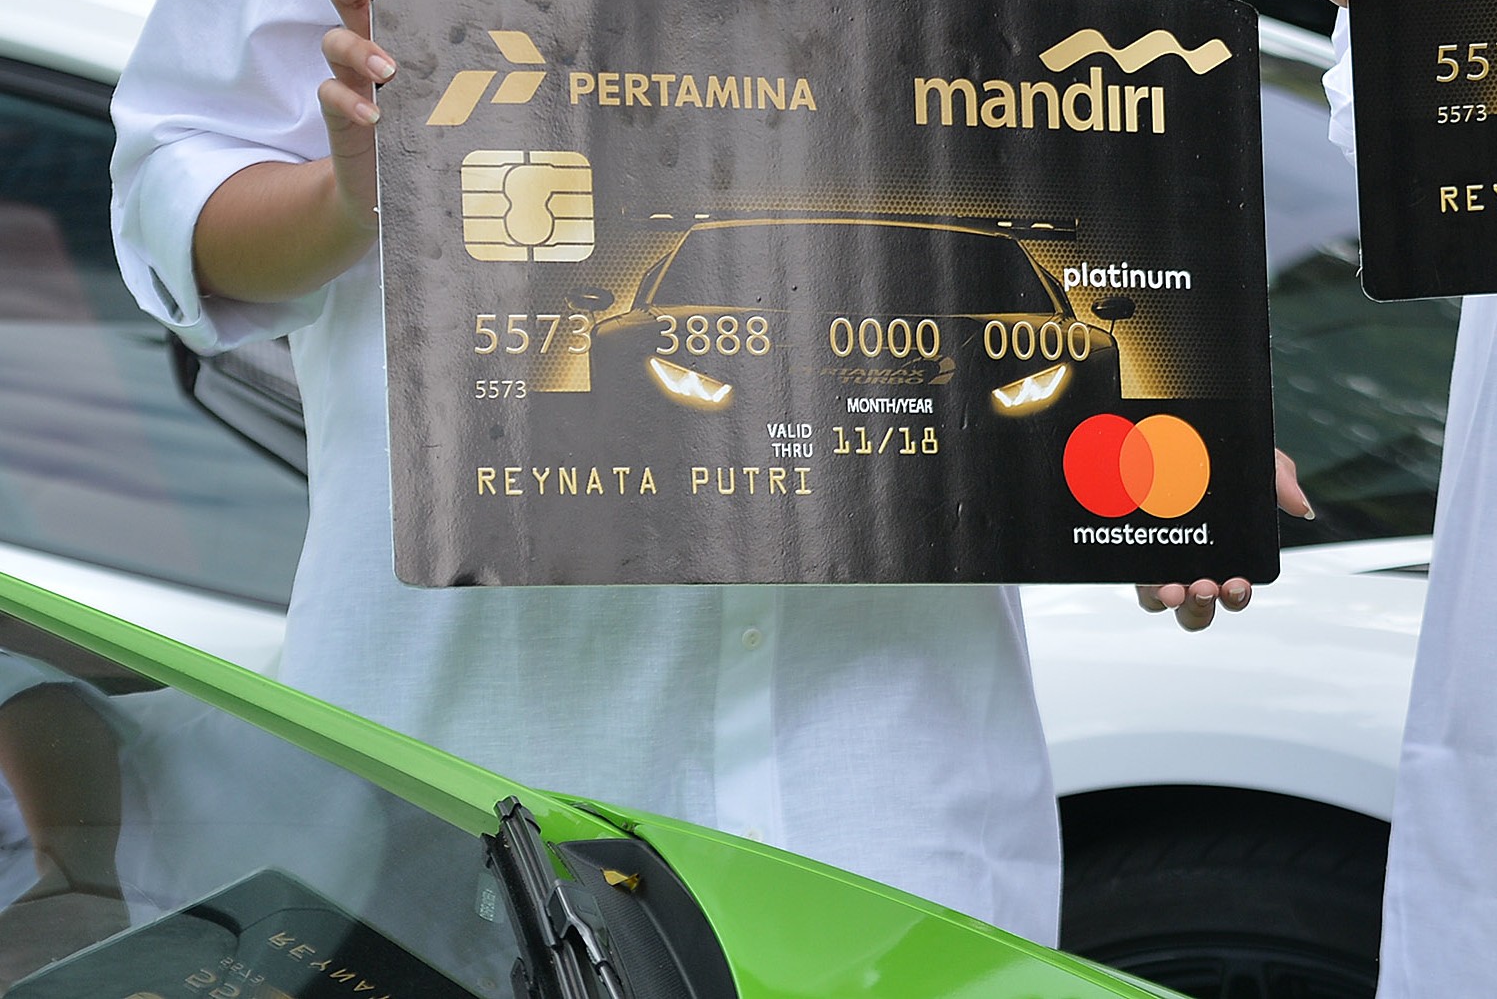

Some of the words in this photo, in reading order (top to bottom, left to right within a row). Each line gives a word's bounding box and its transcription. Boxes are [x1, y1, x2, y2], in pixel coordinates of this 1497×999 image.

[569, 72, 817, 111] PERTAMINA
[914, 67, 1165, 134] mandiri
[1437, 104, 1488, 124] 5573
[1063, 262, 1191, 290] platinum
[474, 314, 592, 355] 5573
[655, 314, 771, 356] 3888
[829, 317, 940, 358] 0000
[983, 320, 1090, 361] 0000
[475, 380, 527, 399] 5573
[839, 376, 925, 385] TURBO
[847, 398, 934, 414] MONTH/YEAR
[767, 423, 812, 440] VALID
[832, 426, 939, 455] 11/18
[772, 443, 813, 458] THRU
[477, 466, 658, 496] REYNATA
[691, 466, 813, 496] PUTRI
